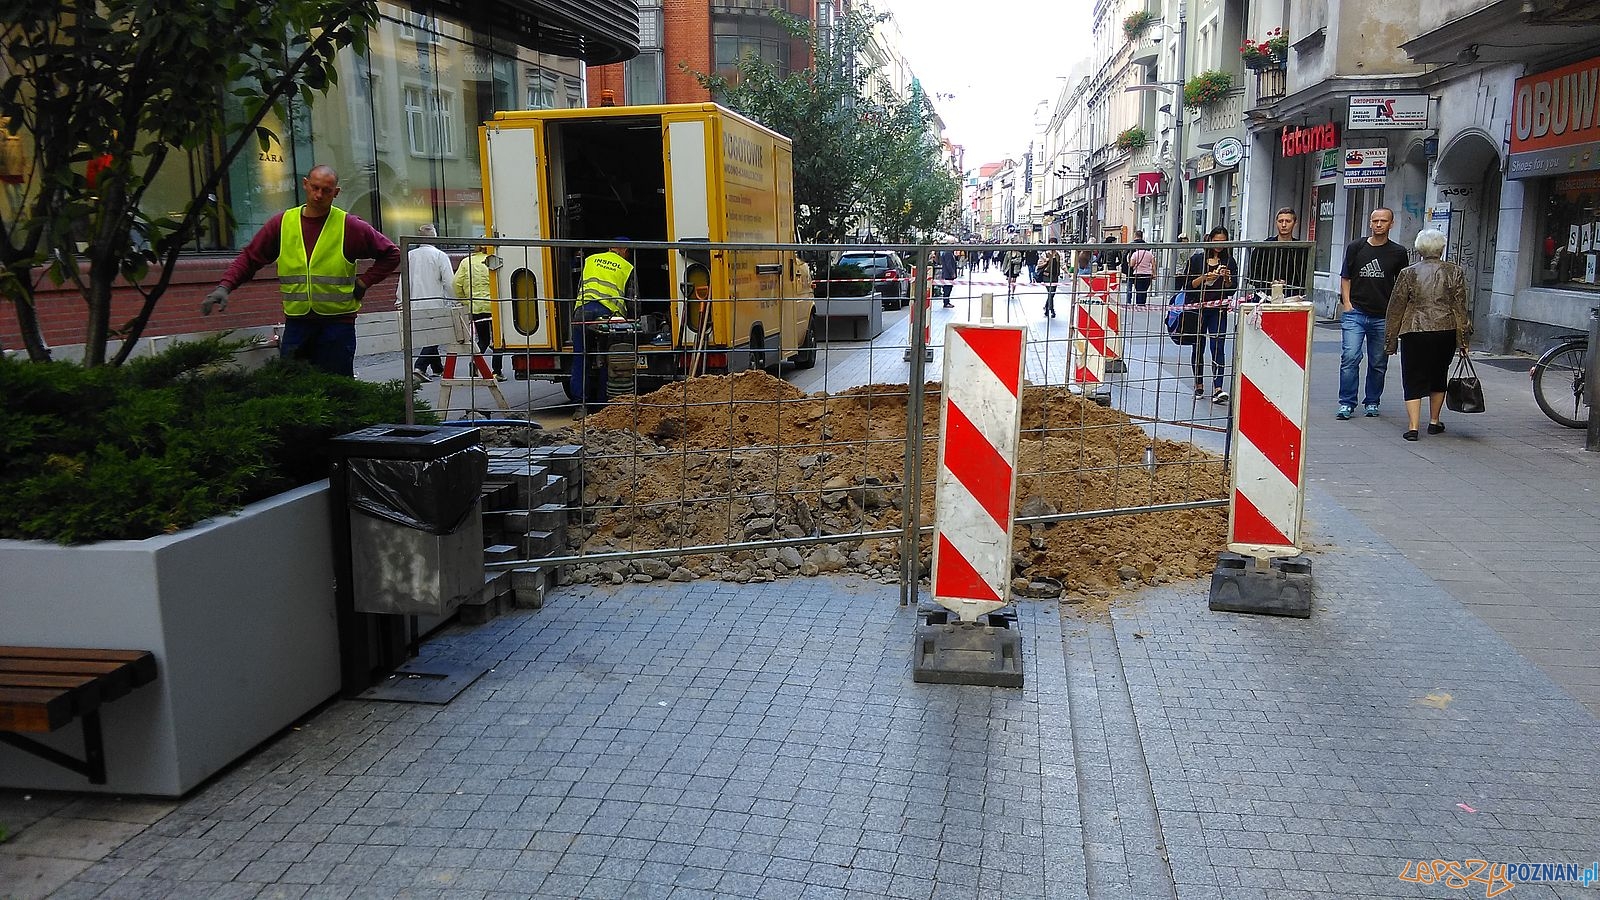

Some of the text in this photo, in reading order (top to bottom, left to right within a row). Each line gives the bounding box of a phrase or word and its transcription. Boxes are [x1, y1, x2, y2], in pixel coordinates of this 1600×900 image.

[259, 153, 284, 162] ZARA
[1511, 158, 1559, 172] Shoes for you
[1145, 180, 1160, 194] M
[594, 258, 622, 270] INSPOL
[1359, 270, 1385, 278] adidas
